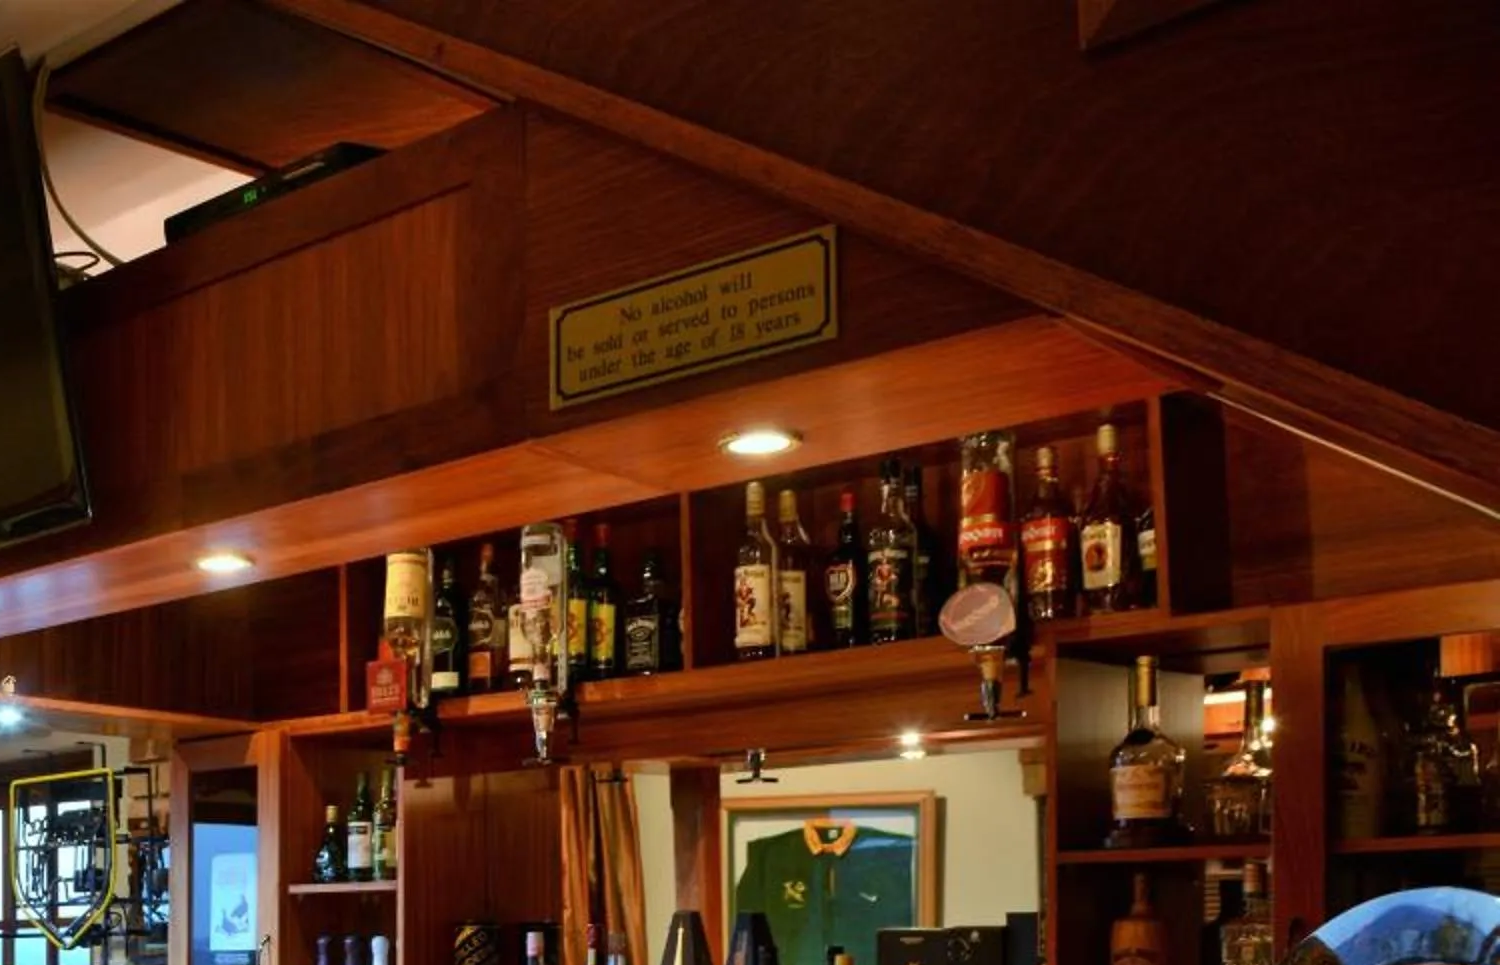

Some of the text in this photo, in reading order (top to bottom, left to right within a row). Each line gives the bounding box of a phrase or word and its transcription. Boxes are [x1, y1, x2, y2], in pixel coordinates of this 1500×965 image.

[567, 283, 816, 363] be sold or served to persons
[619, 272, 752, 324] No alcohol will
[579, 313, 803, 383] under the age of 18 years
